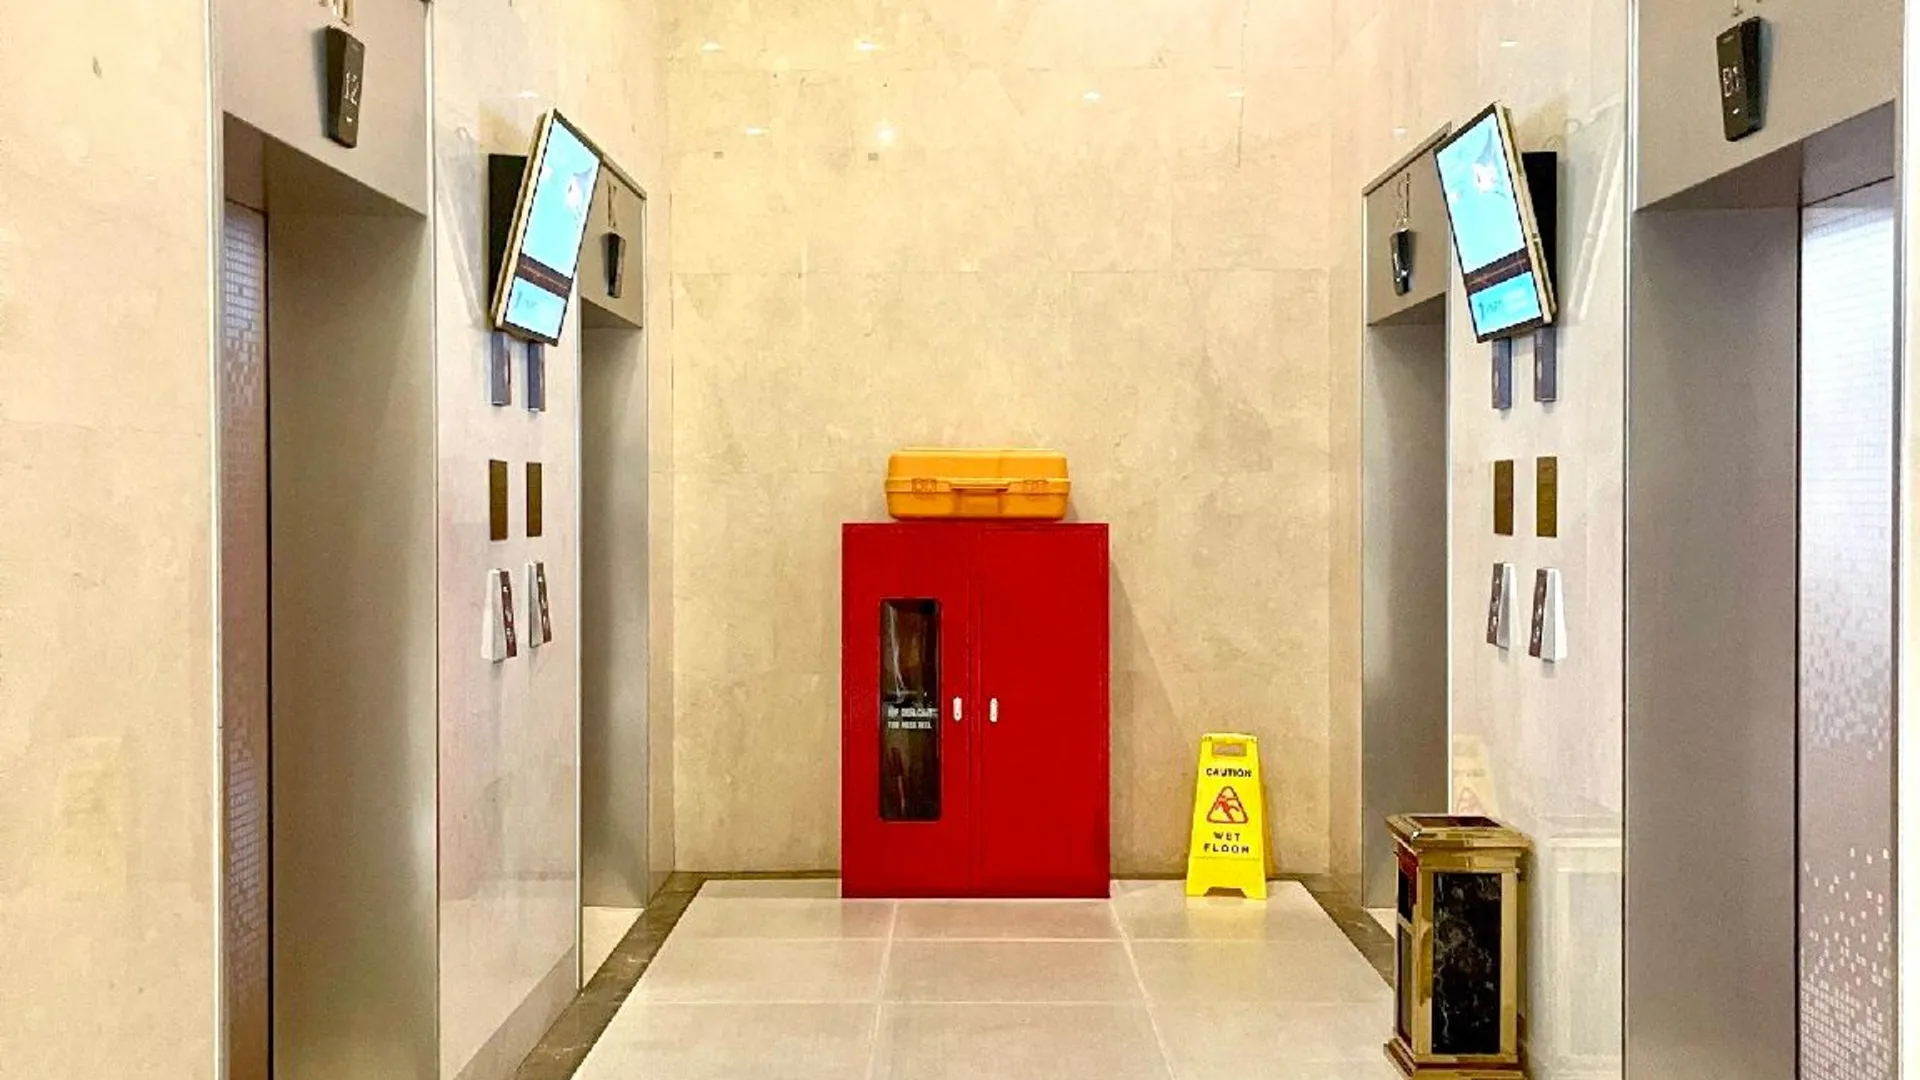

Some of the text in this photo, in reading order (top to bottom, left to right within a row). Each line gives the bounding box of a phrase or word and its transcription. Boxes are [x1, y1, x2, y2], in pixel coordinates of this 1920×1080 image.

[1722, 66, 1740, 97] B1
[345, 71, 359, 105] 12
[1206, 767, 1252, 778] CAUTION
[1214, 831, 1241, 842] WET
[1203, 843, 1250, 854] FLOOR
